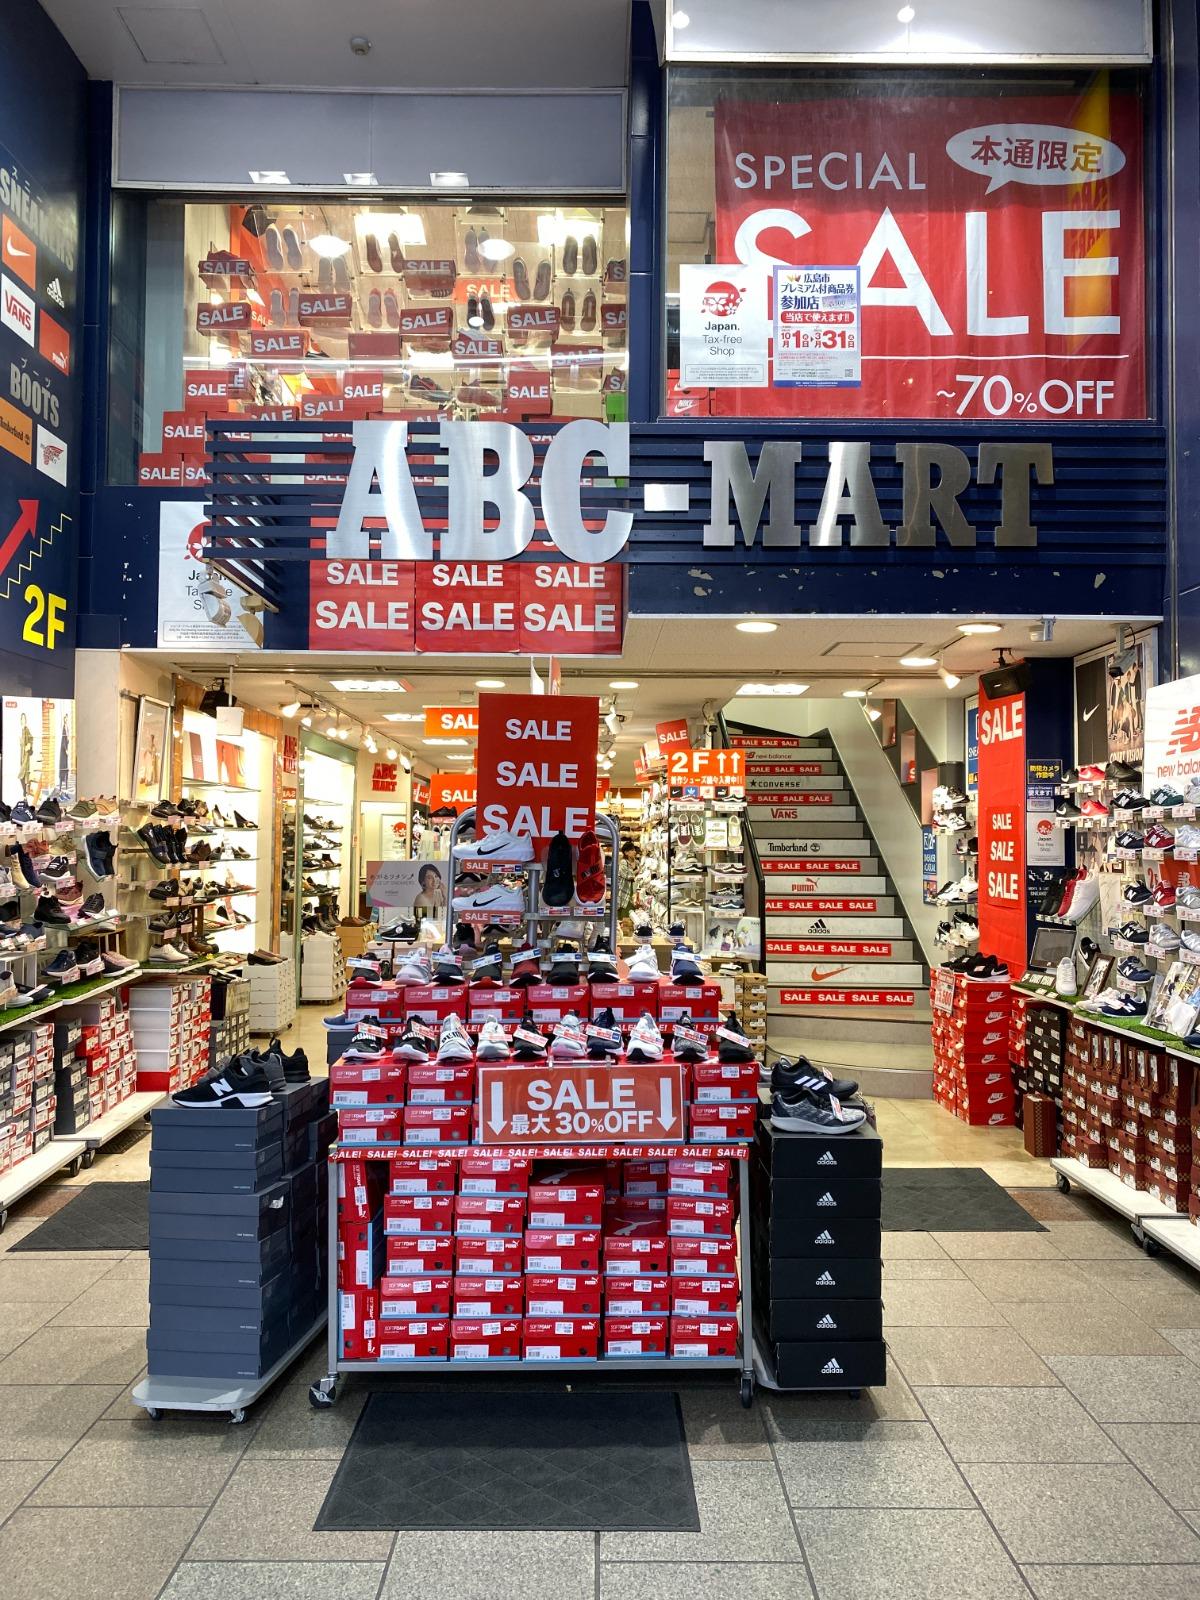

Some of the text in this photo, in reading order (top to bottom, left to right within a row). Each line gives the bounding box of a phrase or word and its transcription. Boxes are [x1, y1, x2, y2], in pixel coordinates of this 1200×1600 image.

[971, 135, 1103, 174] 本通限定
[734, 151, 926, 190] SPECIAL
[203, 262, 246, 274] SALE
[407, 260, 450, 271] SALE
[804, 272, 830, 284] 広島市
[466, 283, 511, 299] SALE
[5, 289, 32, 332] VANS
[301, 297, 346, 315] SALE
[781, 295, 820, 310] 参加店
[200, 305, 244, 327] SALE
[401, 310, 448, 331] SALE
[510, 310, 557, 328] SALE
[605, 309, 625, 324] SA
[704, 321, 740, 332] Japan.
[254, 335, 301, 353] SALE
[454, 341, 499, 355] SALE
[702, 334, 742, 344] Tax-free
[822, 330, 847, 349] 31
[709, 346, 735, 358] Shop
[10, 363, 59, 428] BOOTS
[188, 384, 226, 397] SALE
[344, 384, 382, 399] SALE
[509, 386, 549, 399] SALE
[164, 426, 203, 438] SALE
[140, 468, 180, 480] SALE
[325, 418, 1054, 564] ABC-MART
[327, 562, 398, 586] SALE
[432, 564, 504, 587] SALE
[535, 566, 606, 588] SALE
[22, 584, 67, 650] 2F
[315, 601, 409, 629] SALE
[421, 602, 515, 631] SALE
[524, 604, 616, 632] SALE
[441, 714, 479, 730] SAL
[505, 719, 572, 742] SALE
[981, 701, 1023, 746] SALE
[659, 730, 688, 744] SALE
[372, 762, 398, 780] ABC
[671, 751, 710, 773] 2F
[1157, 757, 1200, 779] new balan
[496, 761, 579, 788] SALE
[482, 803, 590, 839] SALE
[771, 808, 798, 819] VANS
[992, 813, 1012, 831] SALE
[768, 842, 808, 852] Timberland
[990, 841, 1014, 862] SALE
[466, 862, 489, 870] SALE
[791, 884, 814, 892] PUMA
[988, 871, 1018, 900] SALE
[465, 913, 489, 921] SALE
[767, 943, 792, 951] SALE
[799, 944, 825, 952] SALE
[862, 946, 888, 954] SALE
[784, 993, 913, 1003] SALE SALE SALE SALE
[527, 1078, 637, 1112] SALE
[510, 1109, 654, 1136] 最大30%OFF
[367, 1149, 397, 1158] SALE!
[402, 1149, 432, 1158] SALE!
[437, 1149, 468, 1158] SALE!
[472, 1148, 503, 1157] SALE!
[508, 1148, 538, 1157] SALE!
[543, 1148, 573, 1157] SALE!
[578, 1148, 607, 1157] SALE!
[613, 1148, 642, 1157] SALE!
[647, 1148, 677, 1157] SALE!
[682, 1148, 712, 1157] SALE!
[717, 1148, 747, 1158] SALE!
